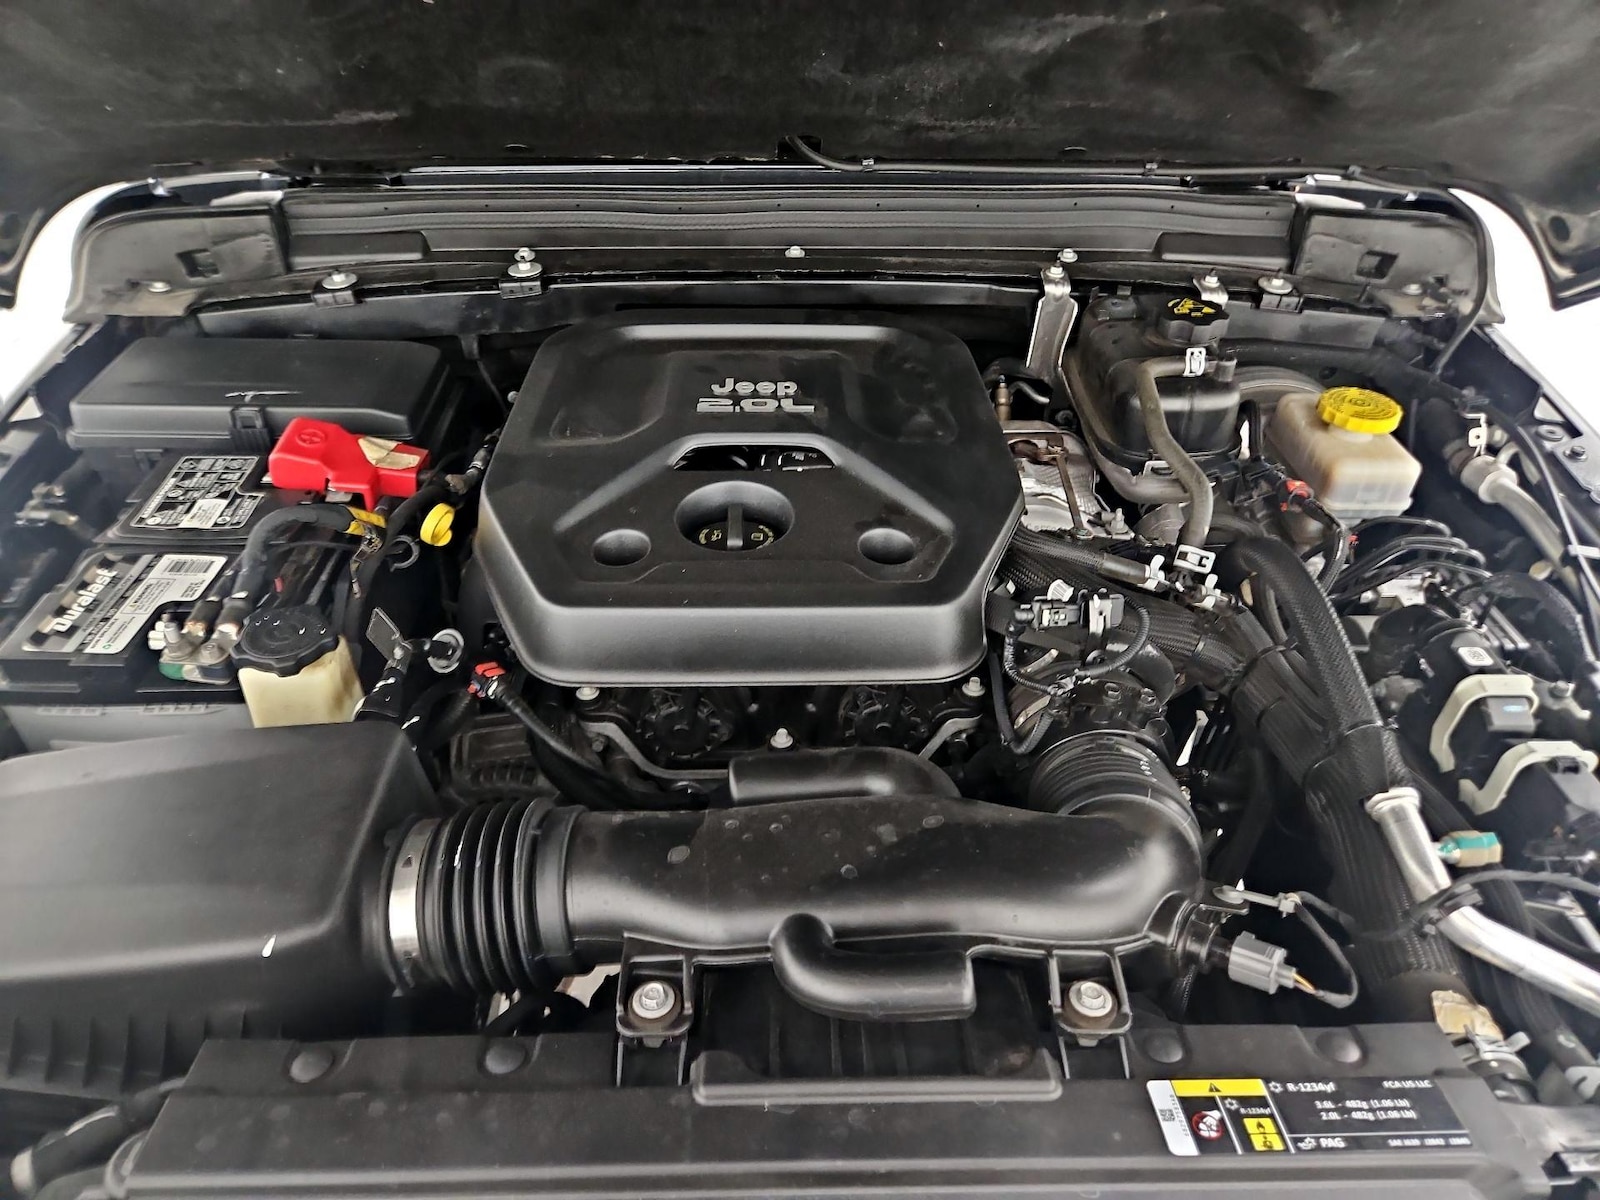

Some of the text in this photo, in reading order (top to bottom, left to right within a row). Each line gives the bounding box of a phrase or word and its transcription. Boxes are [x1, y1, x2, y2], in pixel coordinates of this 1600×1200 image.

[711, 377, 798, 398] Jeep
[696, 397, 815, 413] 2.0L
[45, 568, 118, 634] Duralast
[1286, 1082, 1335, 1093] R-1234yf
[1383, 1079, 1433, 1089] FCA US LLC
[1314, 1100, 1335, 1109] 3.6L
[1345, 1100, 1369, 1109] 482g
[1370, 1099, 1393, 1109] (1.06
[1394, 1098, 1411, 1108] Lb)
[1320, 1111, 1341, 1121] 2.0L
[1351, 1111, 1375, 1121] 482g
[1376, 1110, 1400, 1120] (1.06
[1400, 1109, 1418, 1120] Lb)
[1319, 1137, 1346, 1148] PAG
